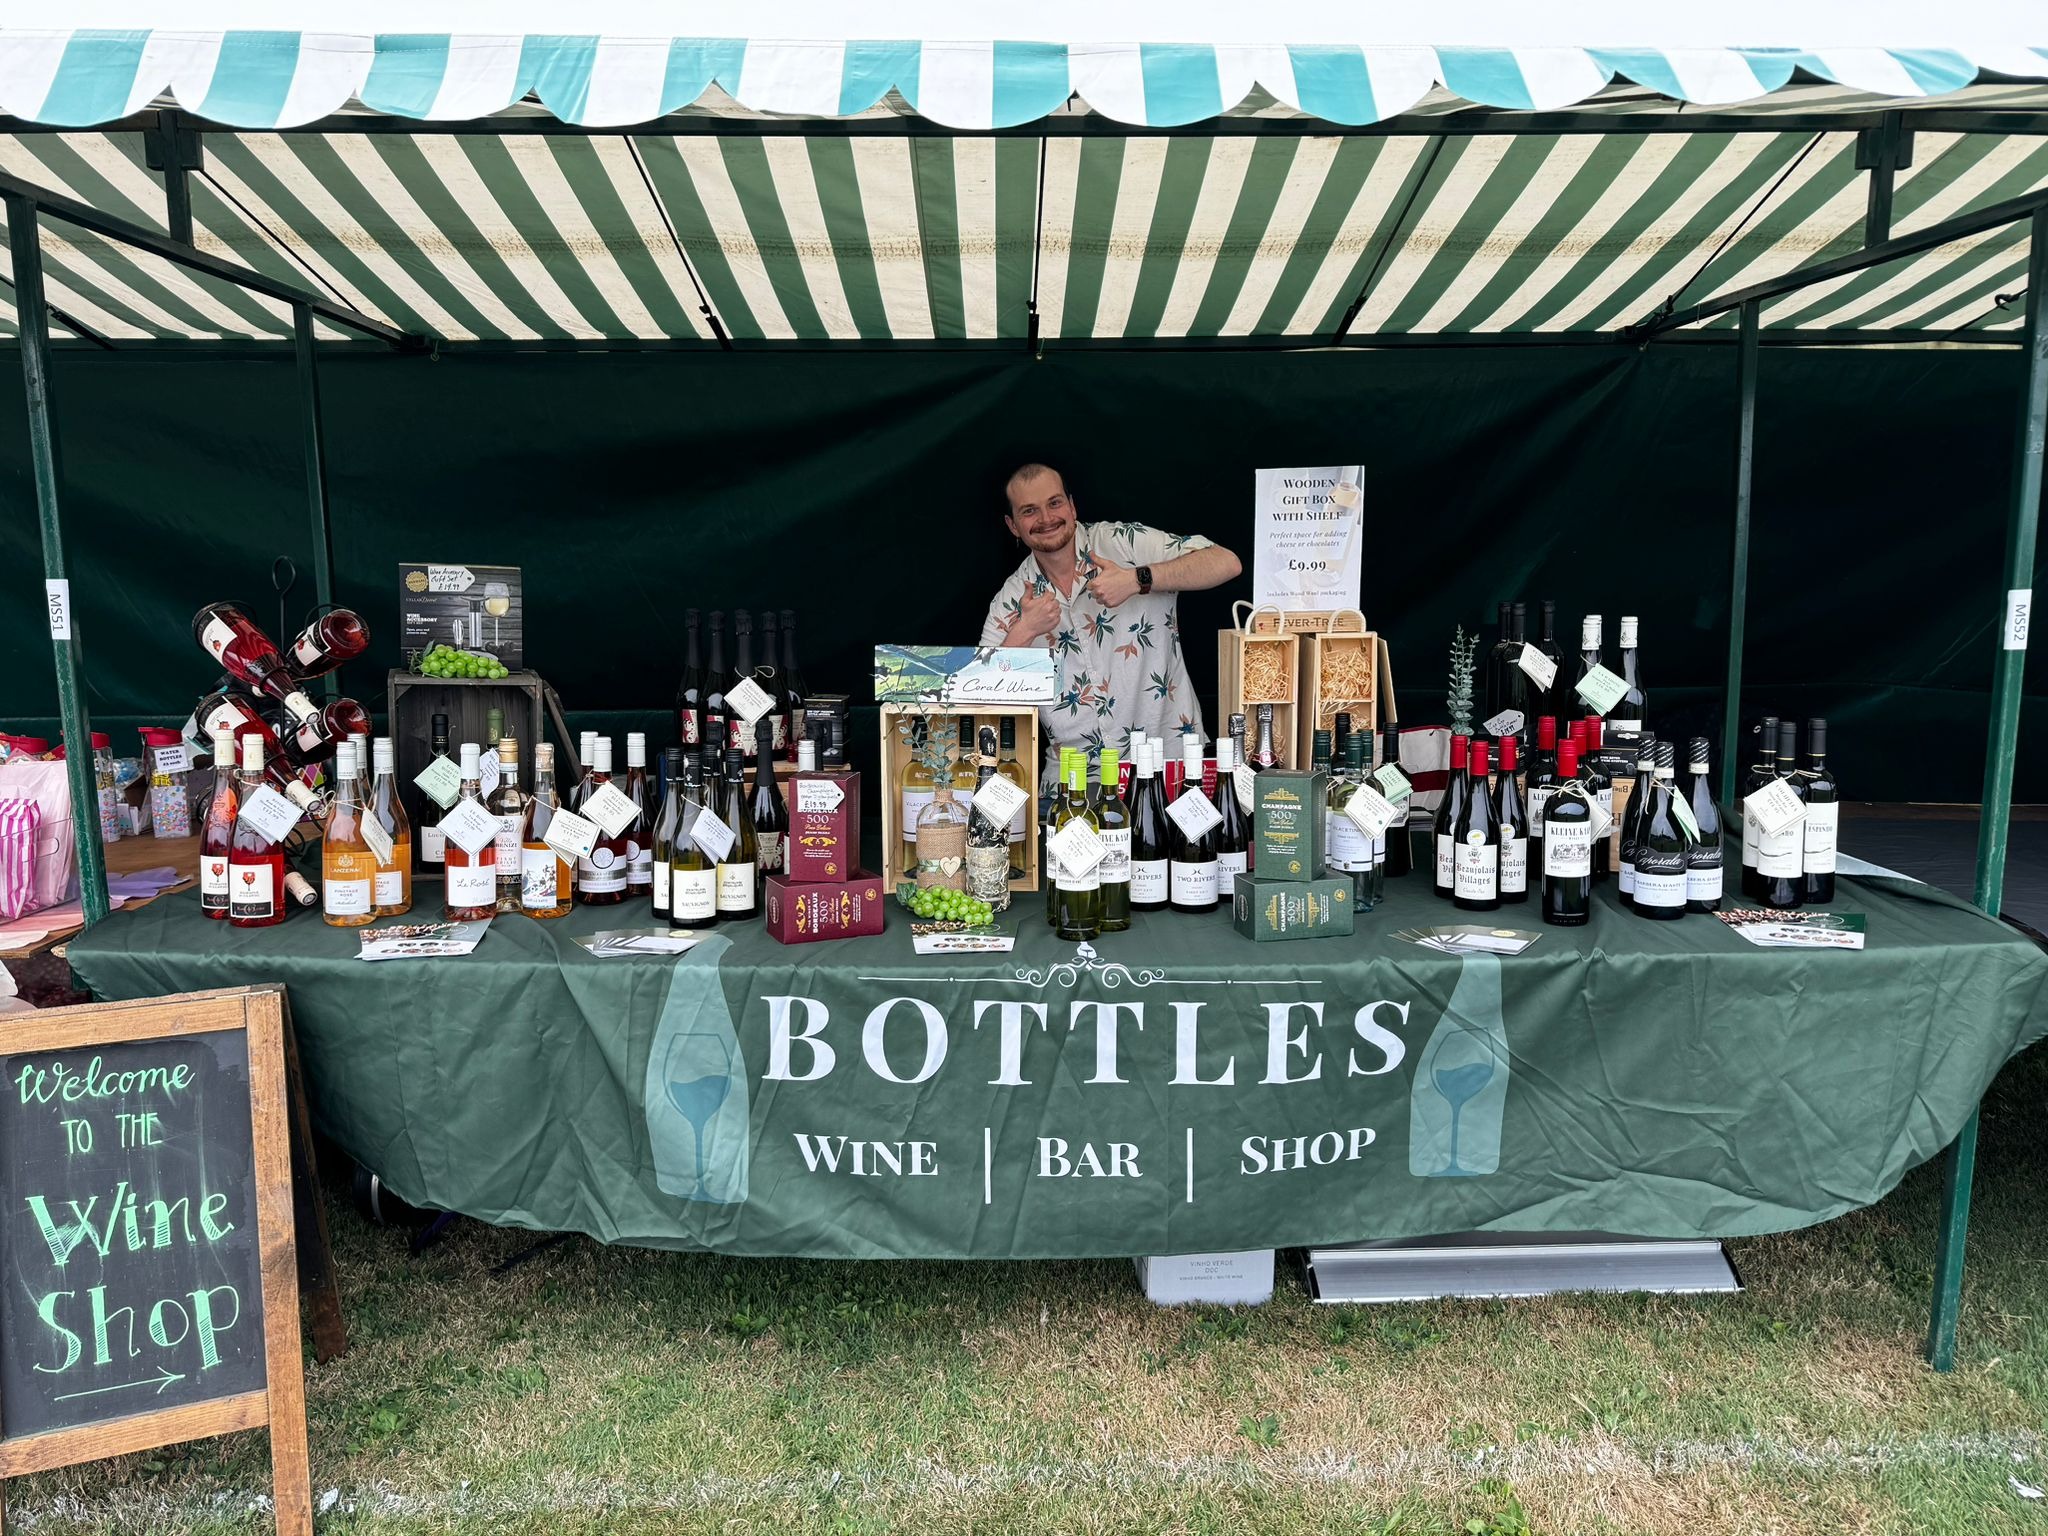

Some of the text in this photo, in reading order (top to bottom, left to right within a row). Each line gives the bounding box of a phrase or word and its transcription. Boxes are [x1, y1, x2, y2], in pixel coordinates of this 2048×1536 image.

[1284, 479, 1336, 489] WOODEN
[1282, 495, 1336, 505] GIFT BOX
[1272, 511, 1343, 521] WITH SHELF
[1324, 530, 1348, 538] adding
[1306, 540, 1340, 548] chocolates
[1287, 559, 1327, 571] £9.99
[447, 574, 458, 583] Set
[50, 593, 65, 632] MS51
[1273, 616, 1344, 628] FVER-TRE
[2013, 604, 2027, 642] MS52
[962, 678, 1048, 693] Coral Wine
[1261, 803, 1303, 811] CHAMPAGNE
[806, 814, 829, 824] 500
[1270, 810, 1292, 820] 500
[1550, 826, 1578, 836] KLEINE
[1456, 862, 1496, 875] Beaujolais
[1501, 859, 1526, 868] ujolais
[1138, 873, 1162, 881] RIVERS
[1501, 869, 1521, 878] lages
[456, 878, 490, 888] Le Rosé
[1193, 875, 1216, 883] RIVERS
[1459, 874, 1491, 885] Villages
[819, 900, 828, 923] 500
[1287, 901, 1296, 923] 500
[761, 995, 1413, 1088] BOTTLES
[15, 1056, 196, 1104] Welcome
[60, 1112, 163, 1155] TO THE
[792, 1127, 1377, 1180] WINE BAR SHOP
[25, 1182, 235, 1267] Wine
[33, 1285, 240, 1374] Shop
